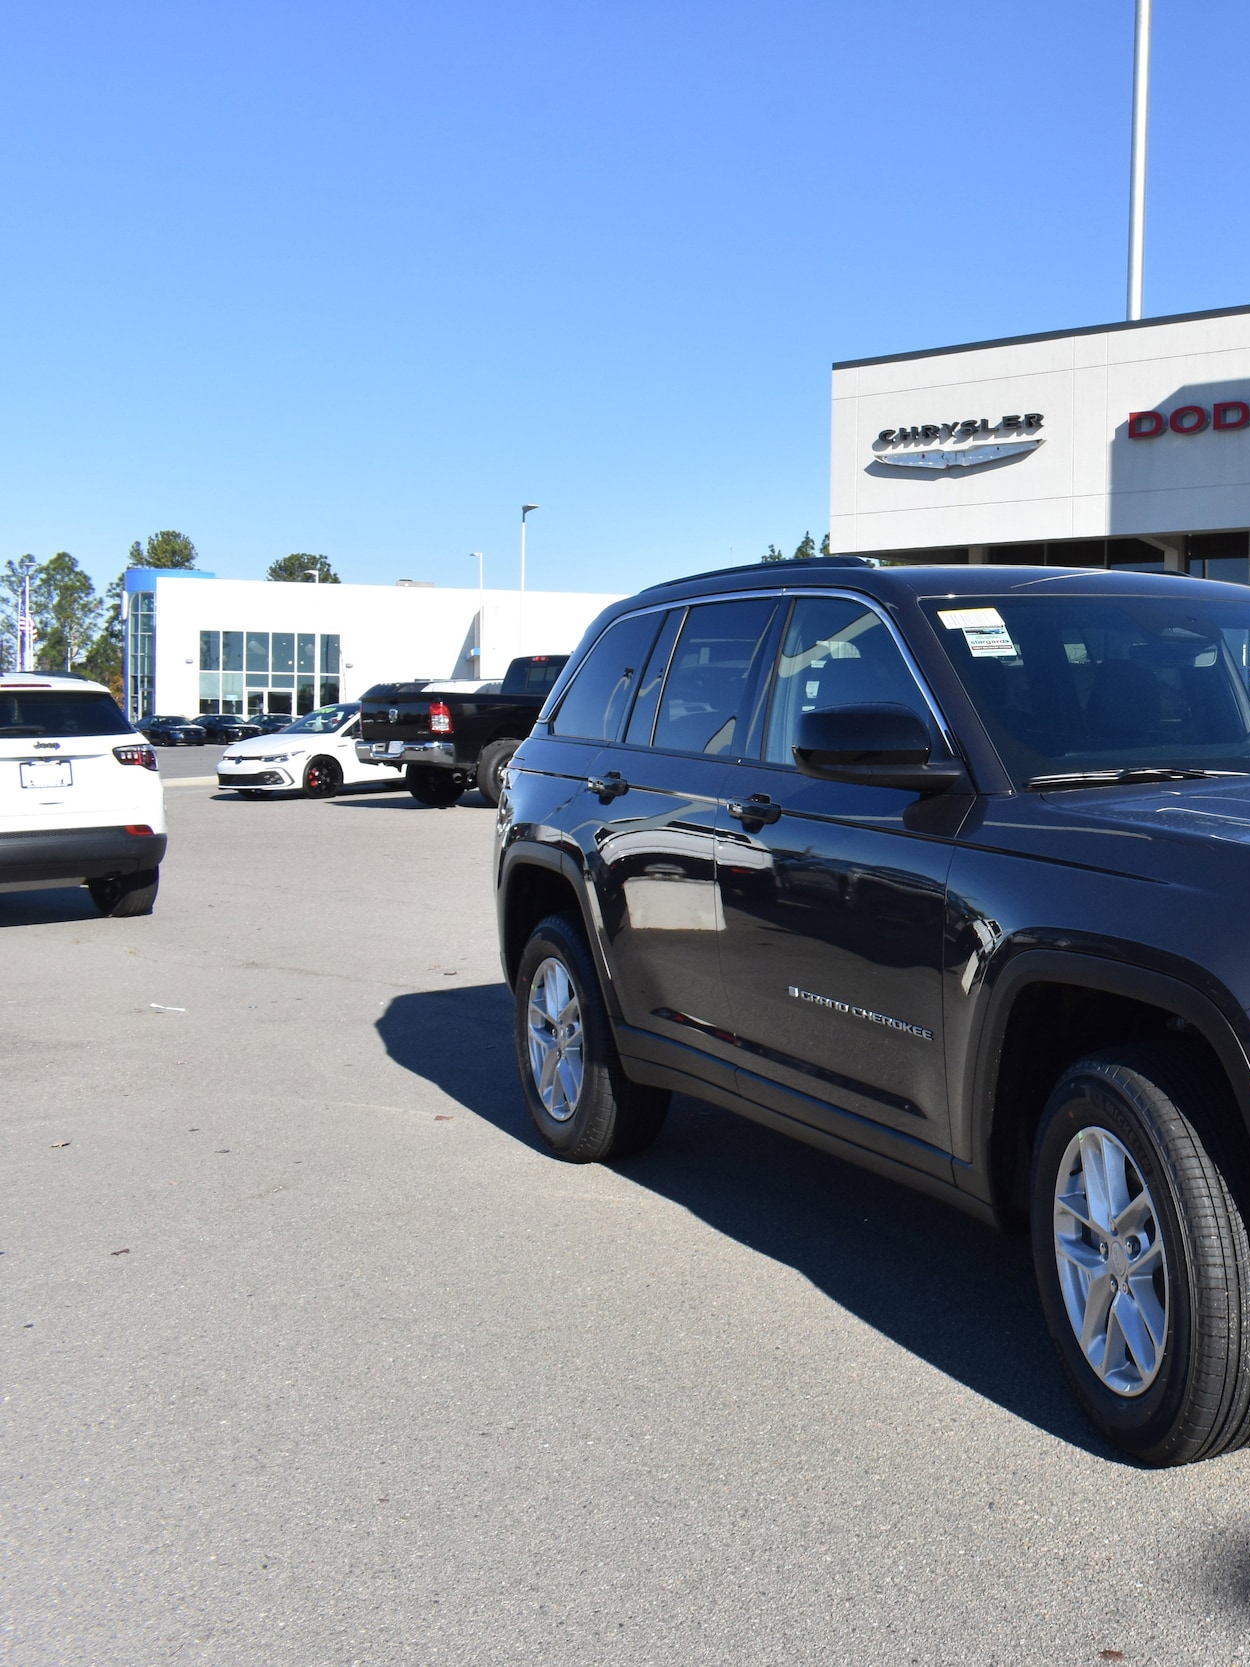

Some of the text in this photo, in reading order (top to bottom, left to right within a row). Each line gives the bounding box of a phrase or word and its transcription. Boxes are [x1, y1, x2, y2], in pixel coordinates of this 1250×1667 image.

[878, 412, 1045, 443] CHRYSLER
[33, 741, 60, 750] Jeep
[800, 990, 934, 1041] GRAND CHEROKEE
